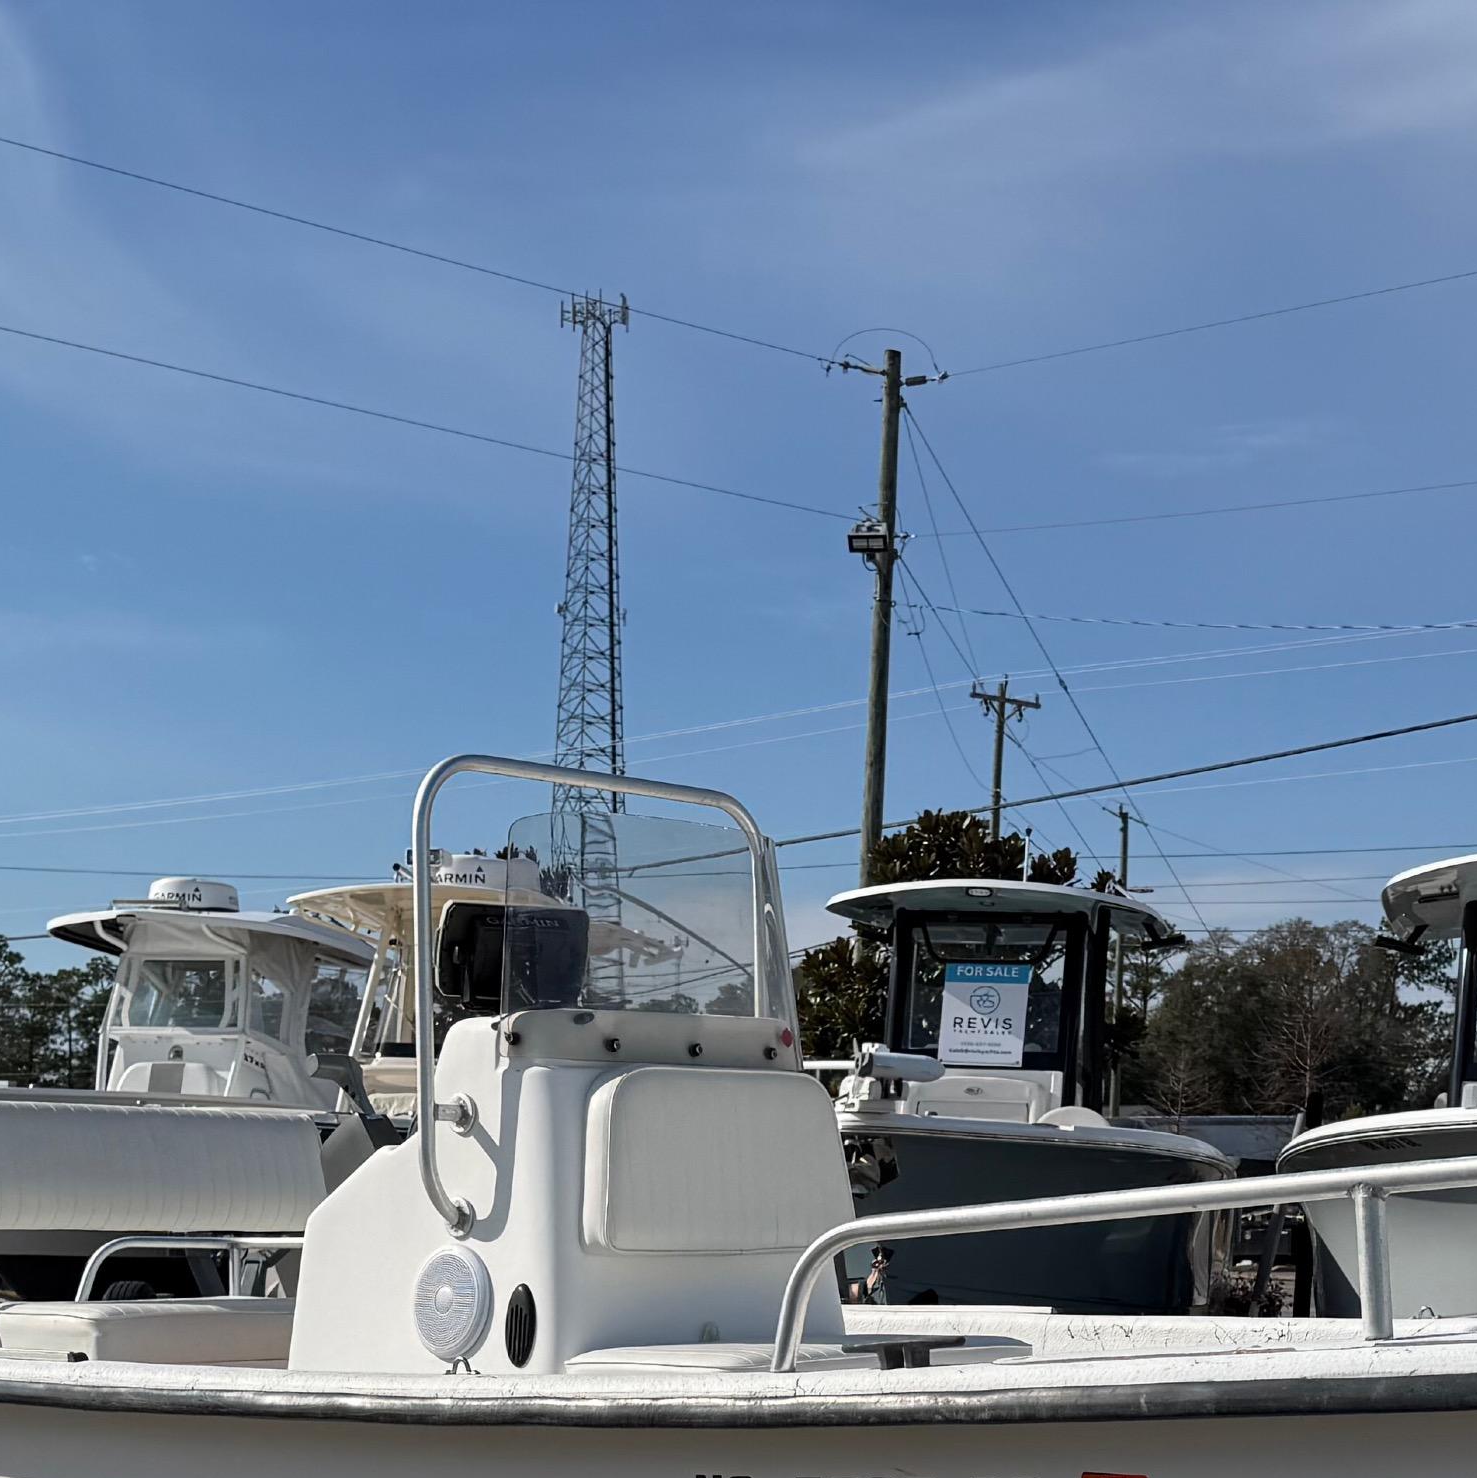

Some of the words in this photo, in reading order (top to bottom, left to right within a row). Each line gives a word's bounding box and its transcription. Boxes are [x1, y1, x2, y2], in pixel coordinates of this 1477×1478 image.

[956, 965, 983, 977] FOR
[986, 966, 1019, 978] SALE
[953, 1016, 1013, 1031] REVIS
